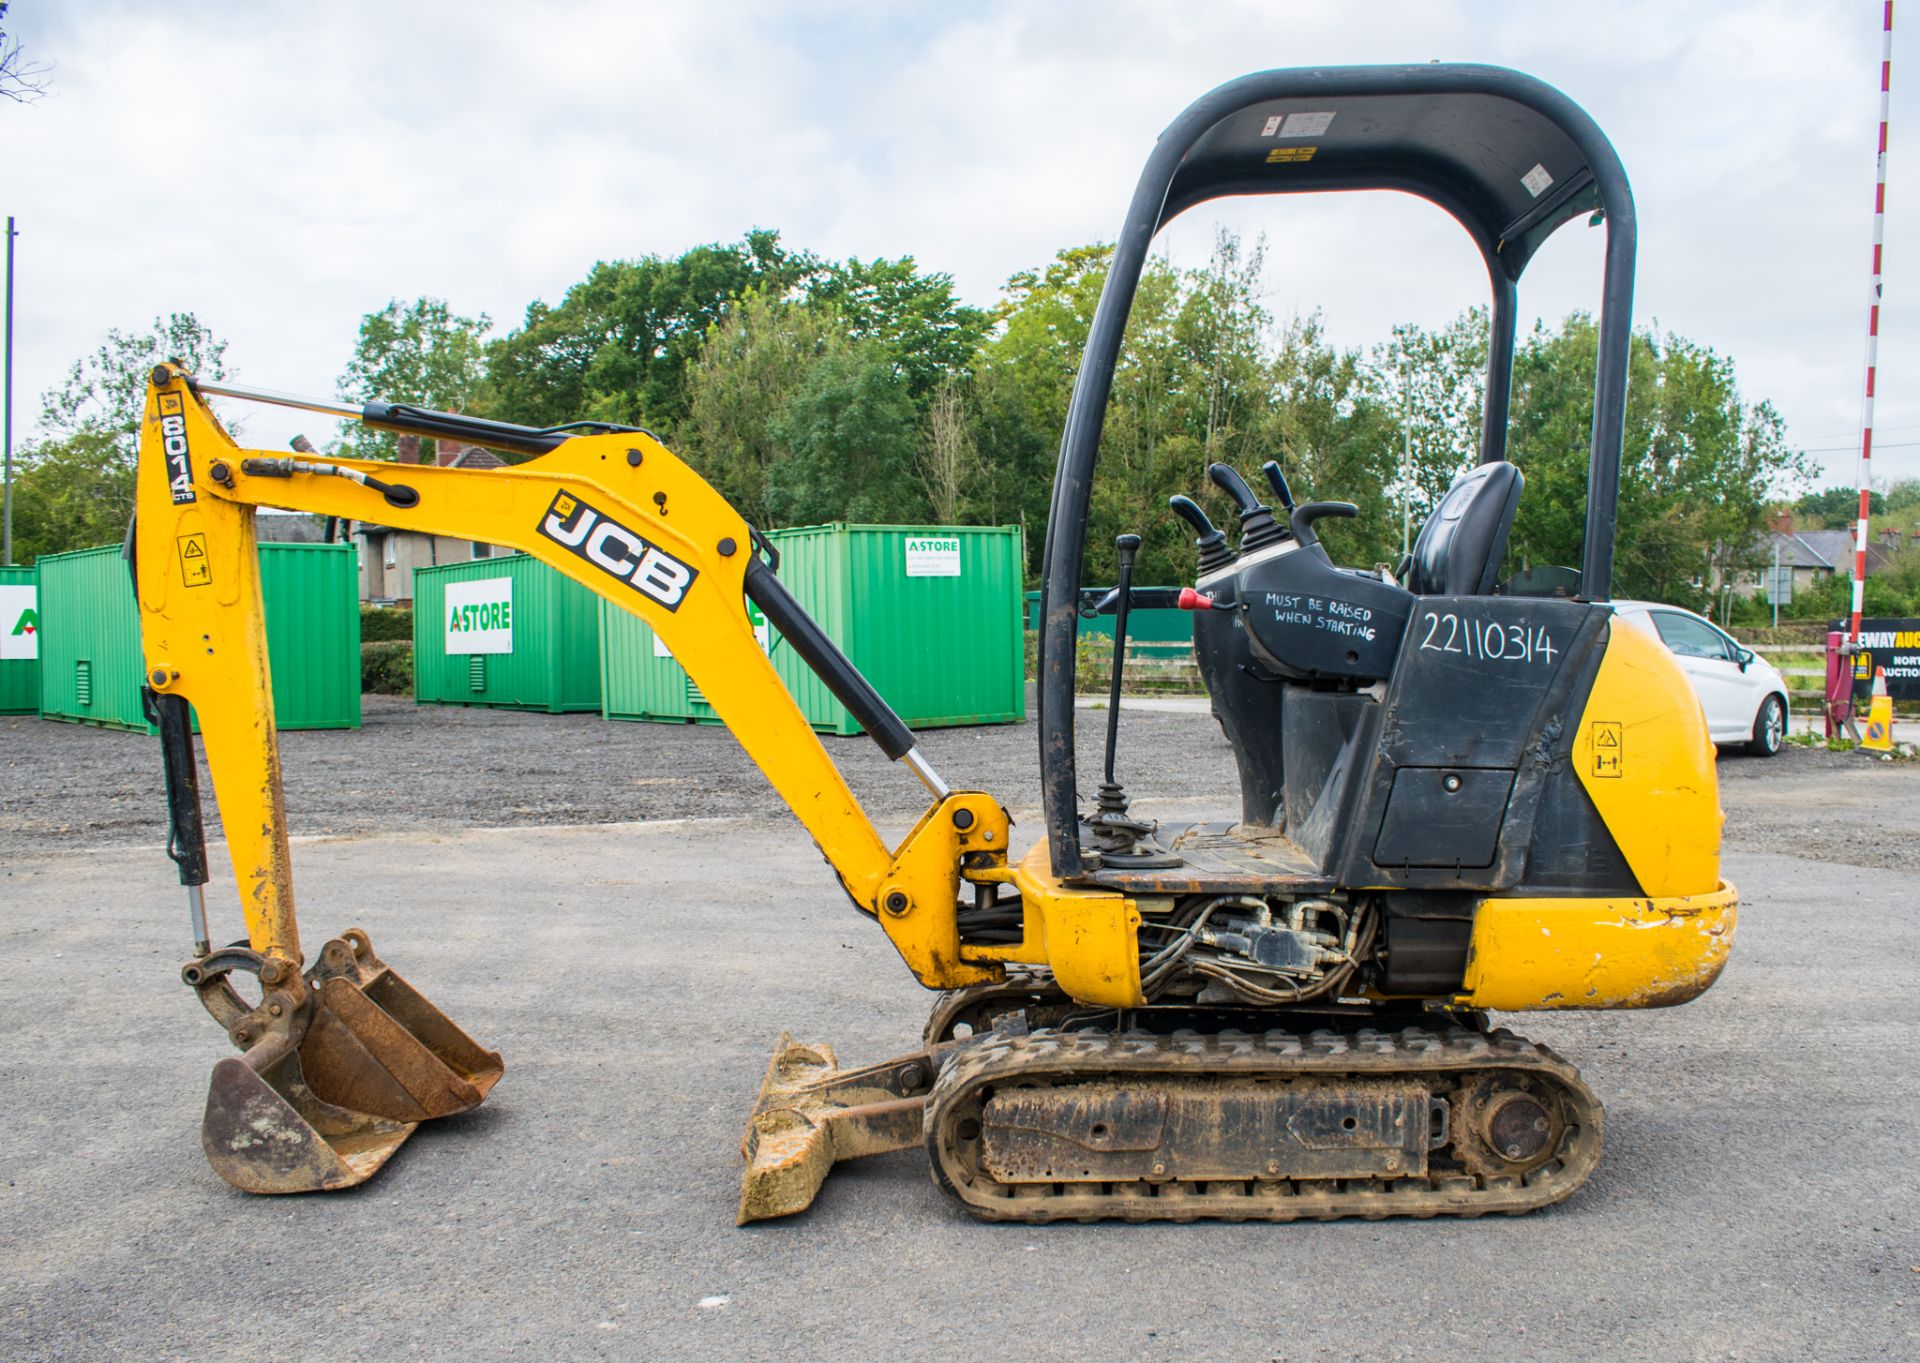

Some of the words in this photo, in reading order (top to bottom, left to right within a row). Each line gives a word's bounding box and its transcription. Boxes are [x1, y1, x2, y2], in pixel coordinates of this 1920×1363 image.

[162, 415, 191, 492] 8014
[173, 492, 194, 501] CTS
[544, 509, 690, 605] JCB
[1265, 592, 1301, 609] MUST
[1308, 598, 1324, 611] BE
[1275, 609, 1312, 625] WHEN
[1419, 612, 1559, 664] 22110314
